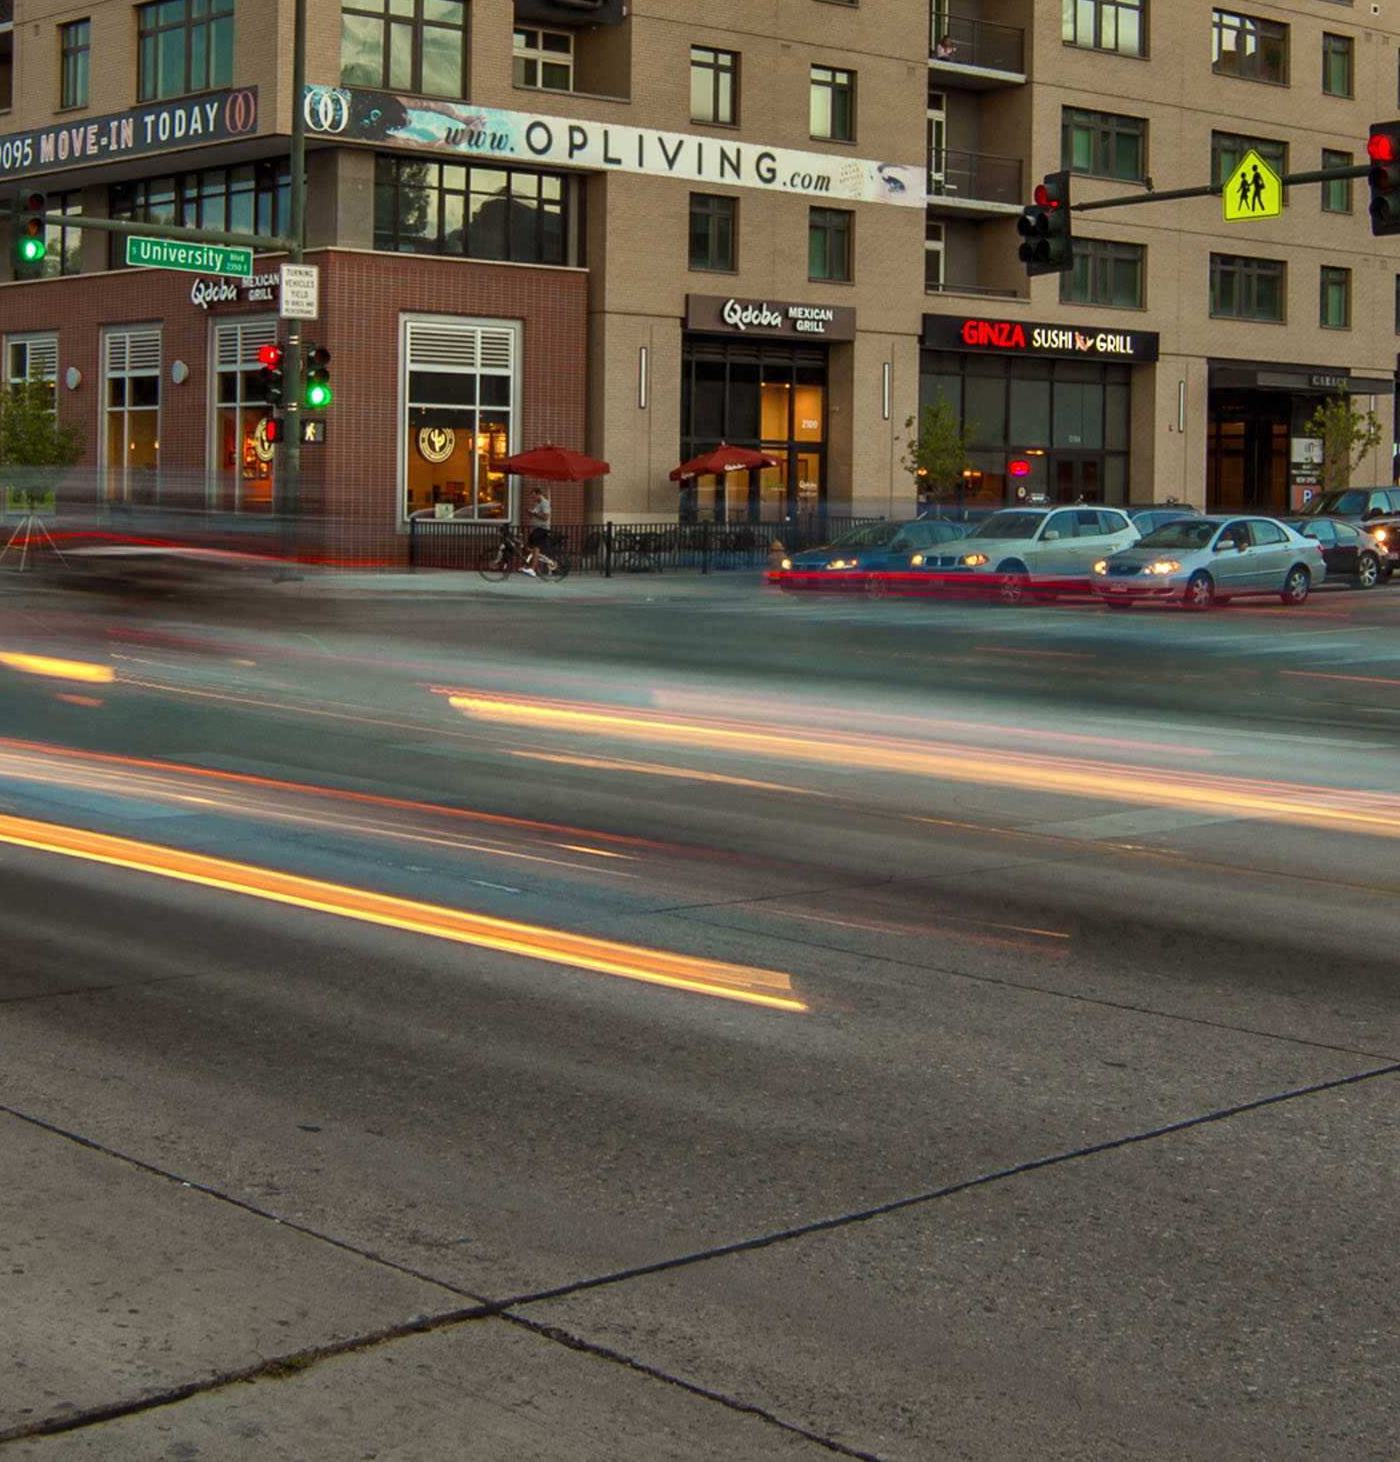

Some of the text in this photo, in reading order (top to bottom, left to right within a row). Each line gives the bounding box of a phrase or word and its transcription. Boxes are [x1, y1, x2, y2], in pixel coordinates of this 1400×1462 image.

[40, 117, 134, 164] MOVE-IN
[143, 101, 219, 144] TODAY
[140, 241, 224, 272] University
[190, 277, 273, 309] Qdoba GRILL
[243, 274, 279, 288] MEXICAN
[723, 298, 782, 331] Qdoba
[788, 306, 833, 321] MEXICAN
[796, 320, 825, 333] GRILL
[963, 320, 1134, 354] GINZA SUSHI GRILL
